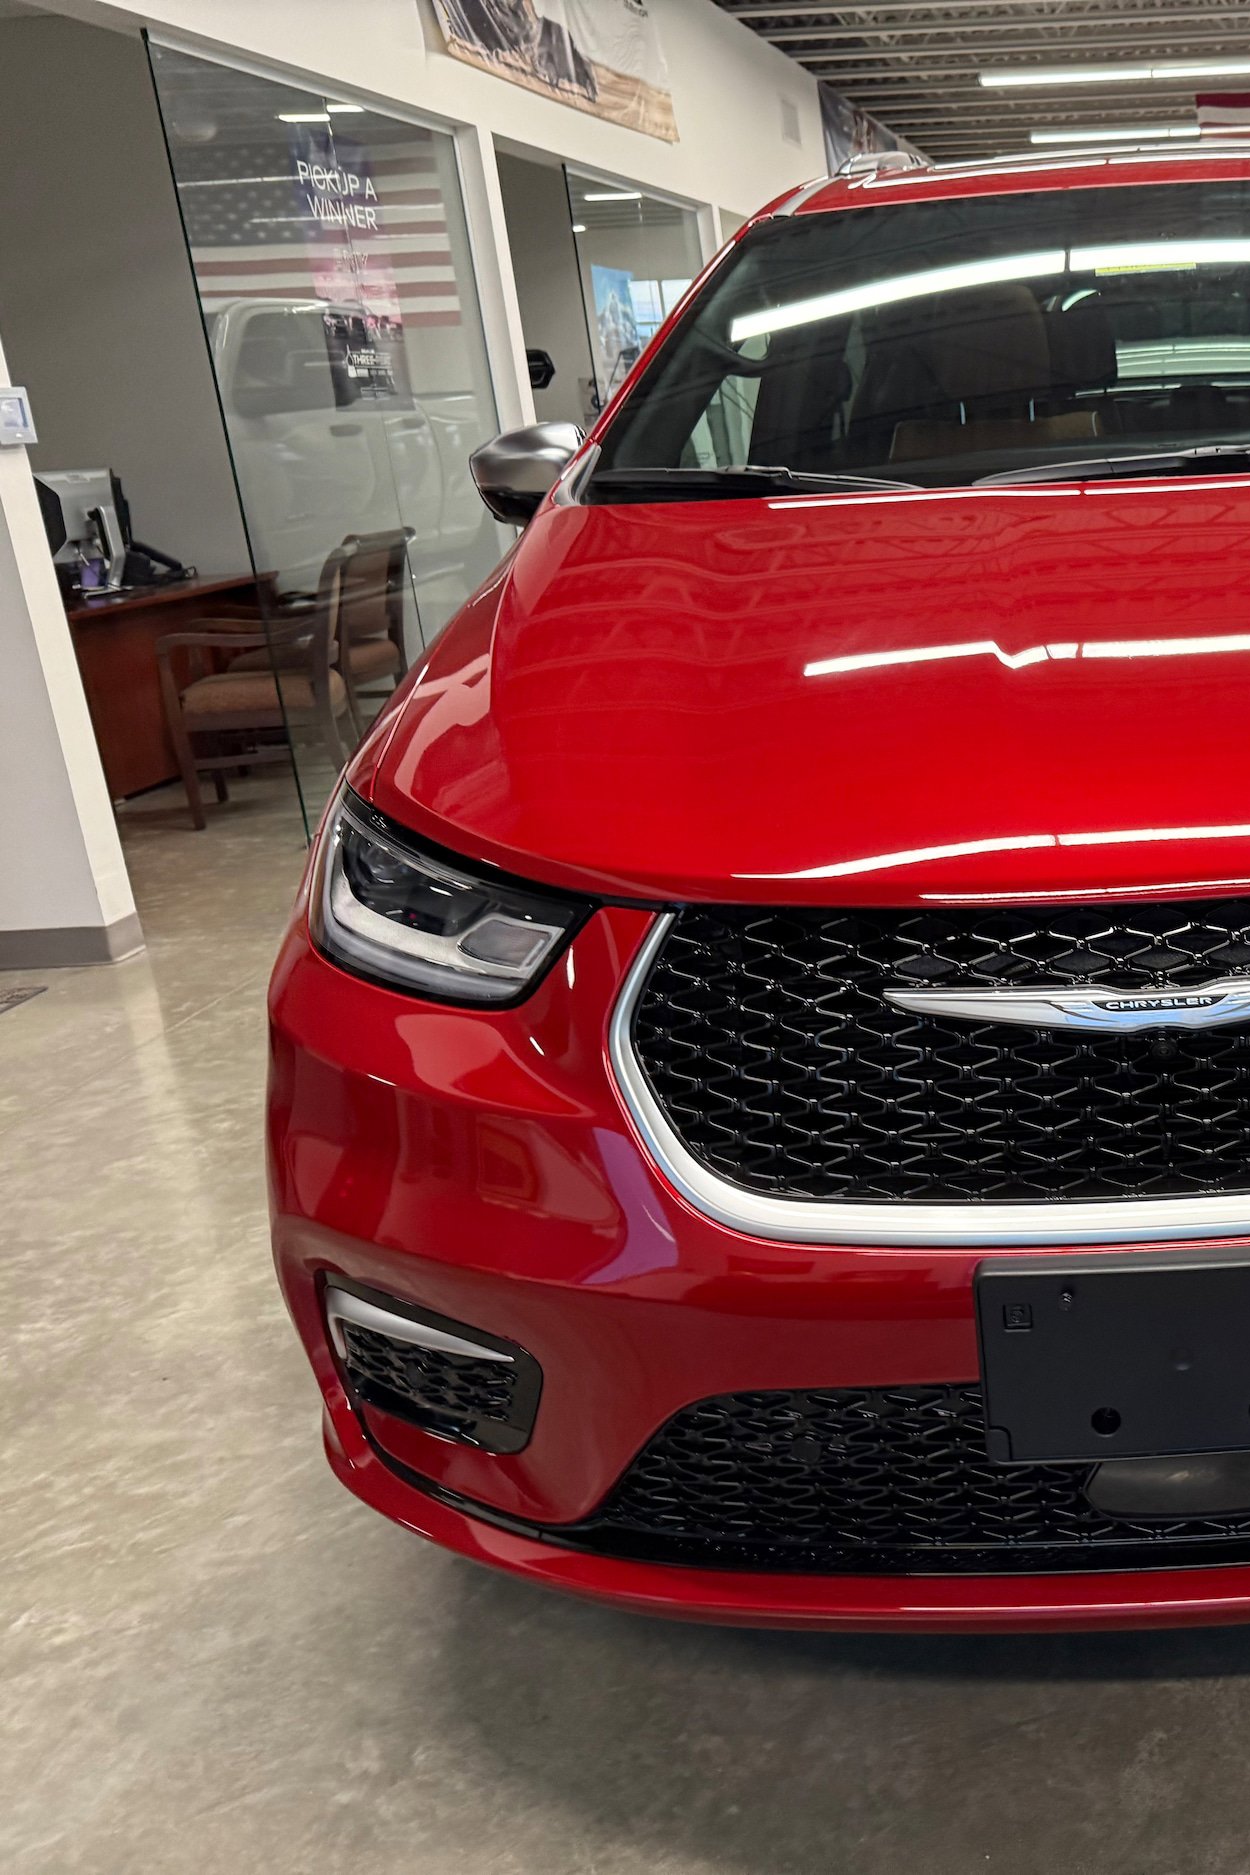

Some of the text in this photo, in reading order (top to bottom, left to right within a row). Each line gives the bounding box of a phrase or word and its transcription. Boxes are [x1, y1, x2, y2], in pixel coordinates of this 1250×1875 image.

[365, 177, 379, 202] A
[306, 193, 379, 231] WINNER
[1105, 996, 1213, 1010] CHRYSLER
